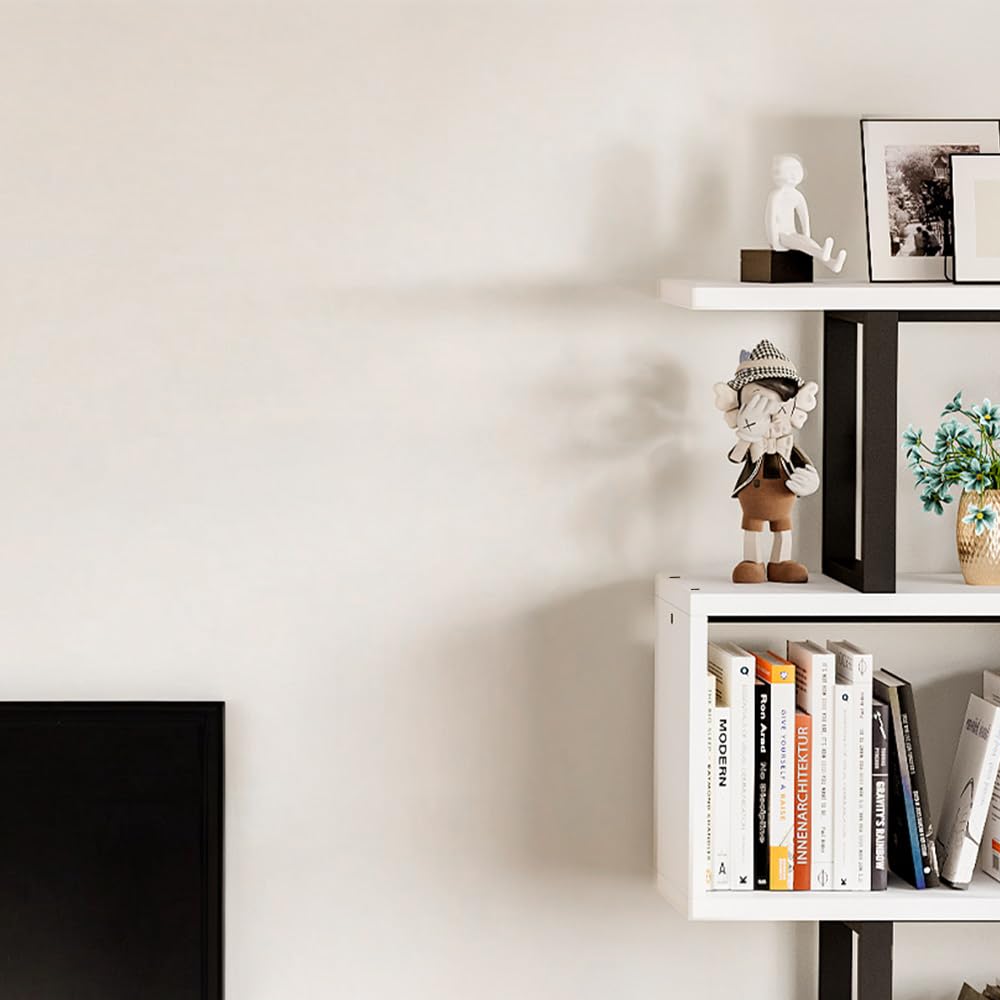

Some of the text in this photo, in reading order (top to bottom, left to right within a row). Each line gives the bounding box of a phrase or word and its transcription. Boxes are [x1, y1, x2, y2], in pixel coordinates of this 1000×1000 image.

[719, 719, 727, 786] MODERN
[760, 762, 766, 777] No
[797, 727, 808, 864] INNENARCHITEKTUR
[876, 780, 887, 828] GRAVITY'S
[876, 827, 887, 871] RAINBOW
